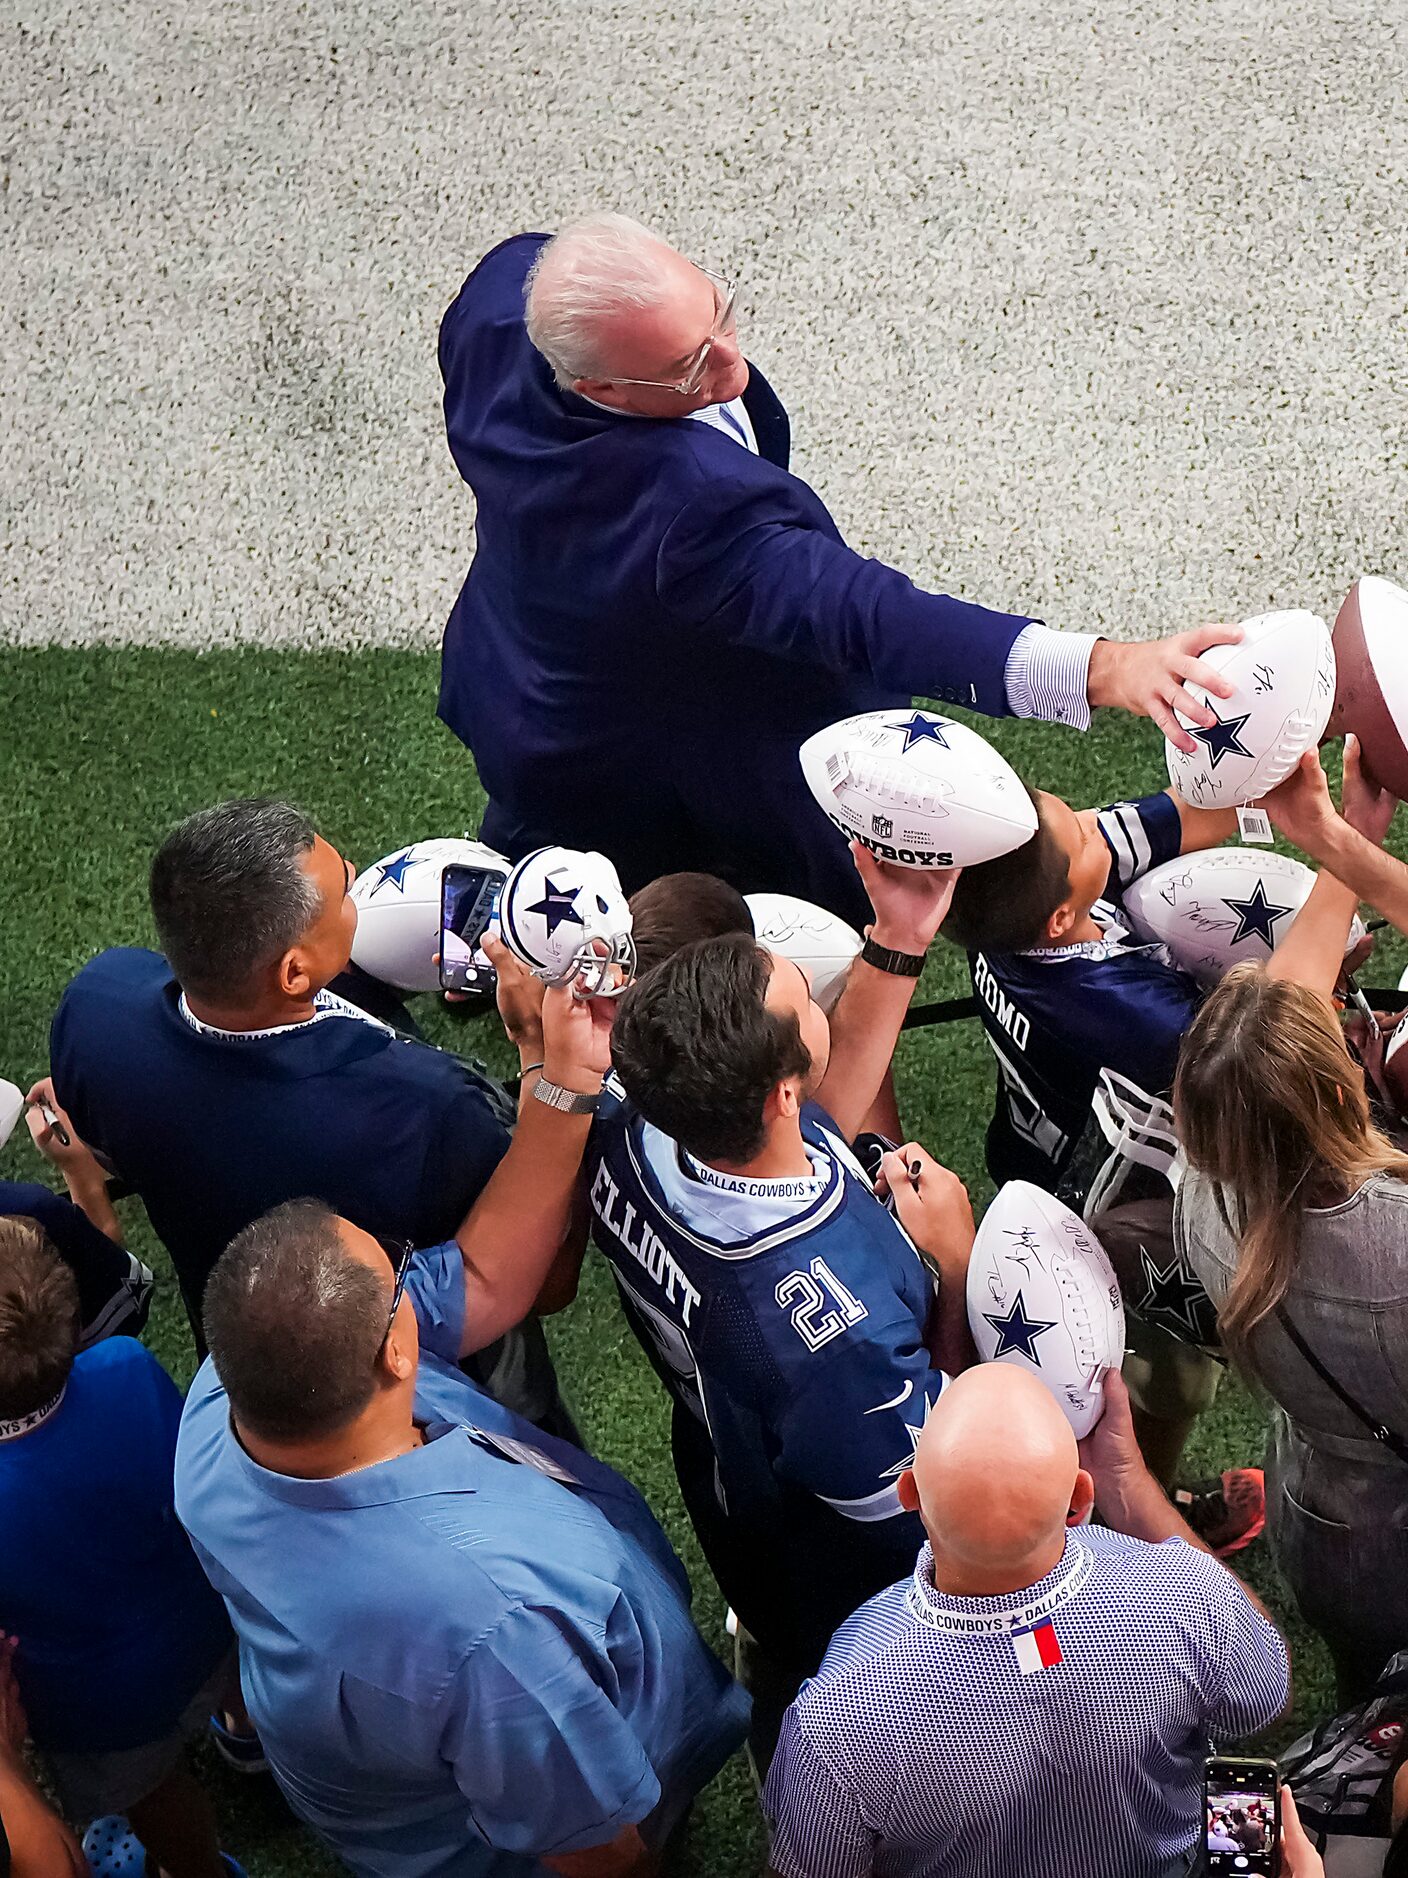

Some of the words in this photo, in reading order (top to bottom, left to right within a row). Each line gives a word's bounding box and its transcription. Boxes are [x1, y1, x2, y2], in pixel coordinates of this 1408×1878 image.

[874, 822, 892, 837] NFL
[974, 951, 1031, 1051] ROMO
[699, 1167, 747, 1196] DALLAS
[749, 1179, 805, 1198] COWBOYS
[589, 1156, 701, 1329] ELLIOTT
[774, 1255, 870, 1354] 21
[936, 1614, 1003, 1633] COWBOYS
[1025, 1586, 1069, 1622] DALLAS
